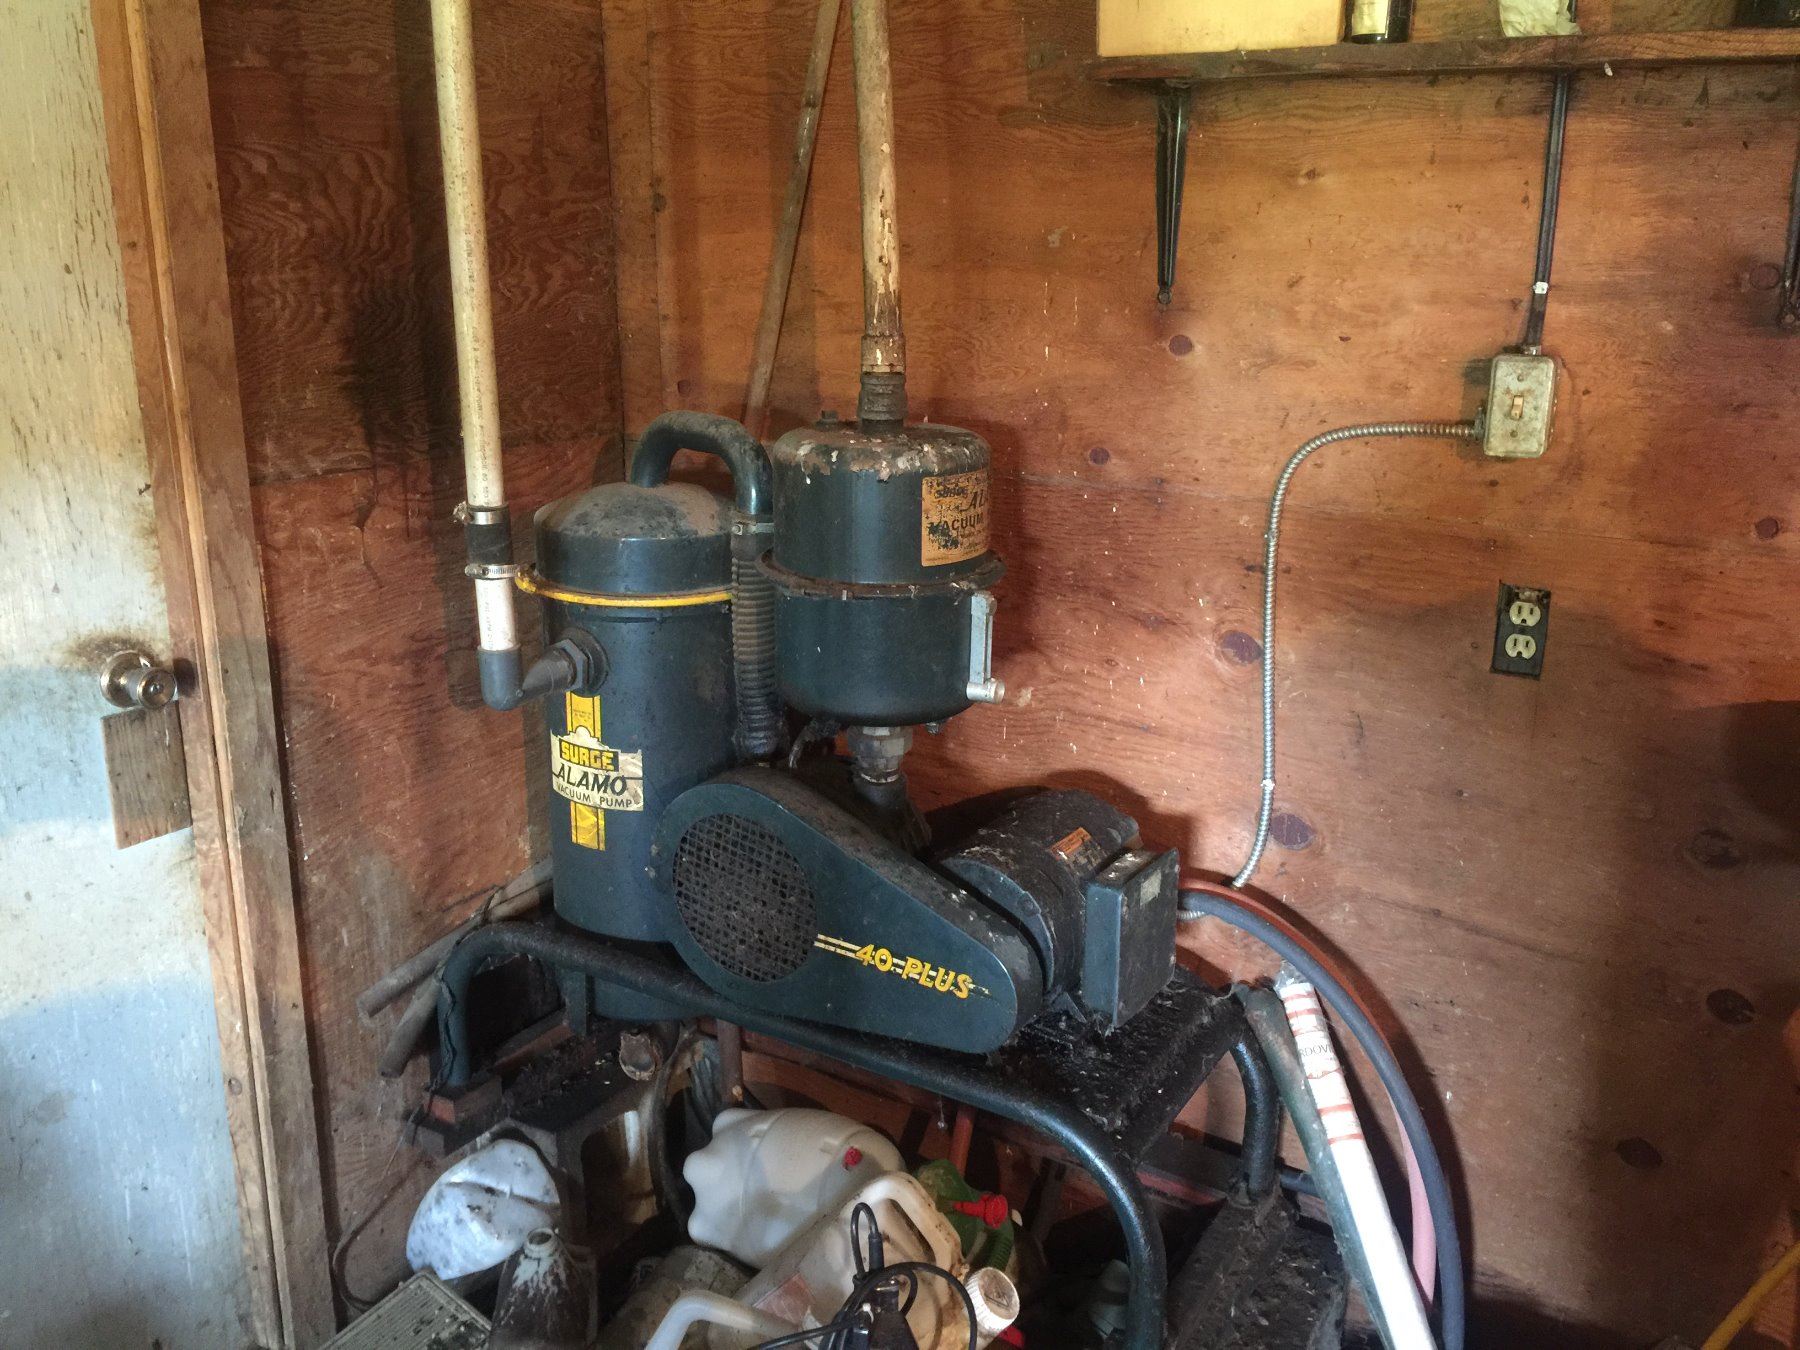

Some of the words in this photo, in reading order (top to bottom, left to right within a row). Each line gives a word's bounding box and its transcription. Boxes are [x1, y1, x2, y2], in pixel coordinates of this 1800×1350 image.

[561, 740, 615, 771] SURGE
[556, 781, 592, 804] VACUUM
[599, 796, 634, 808] PUMP
[557, 763, 628, 796] ALAMO
